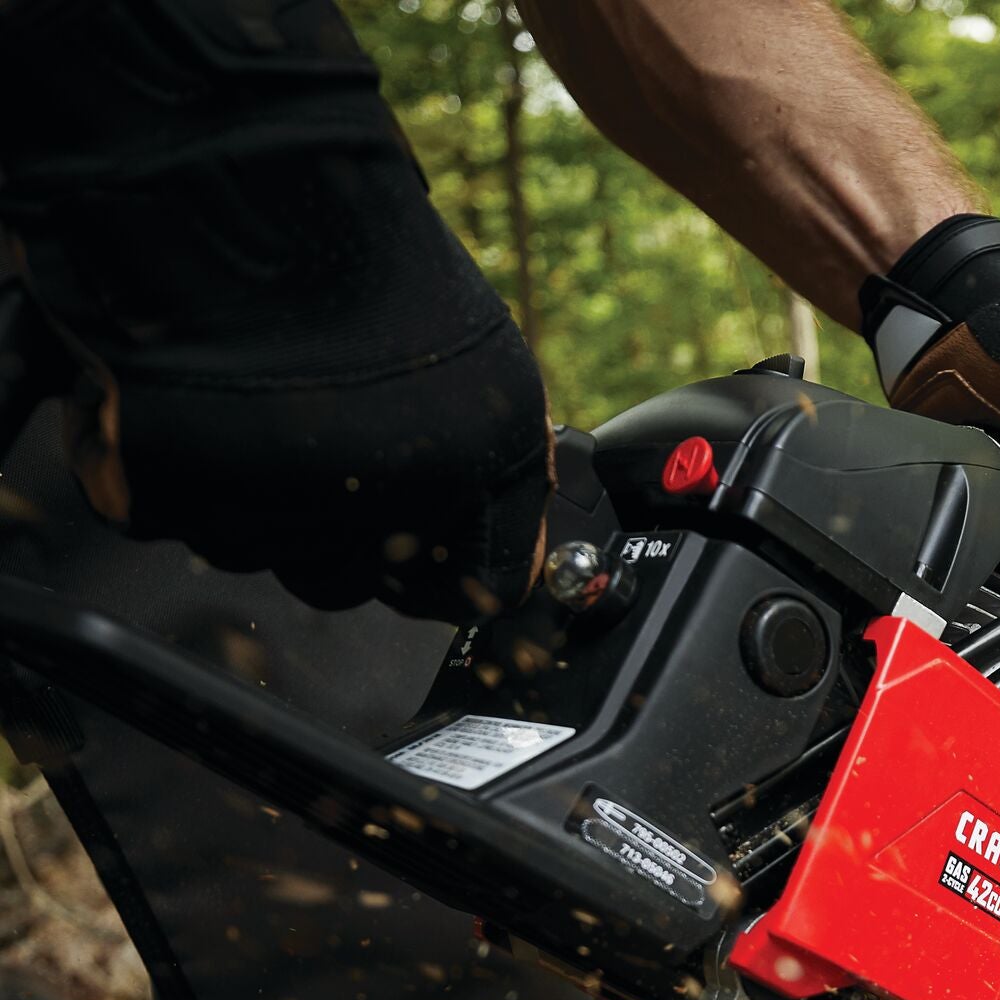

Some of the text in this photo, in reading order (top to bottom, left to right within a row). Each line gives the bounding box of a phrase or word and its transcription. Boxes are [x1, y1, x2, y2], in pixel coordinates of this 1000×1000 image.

[645, 540, 671, 557] 10x
[945, 856, 971, 883] GAS
[941, 873, 966, 894] 2-CYCLE
